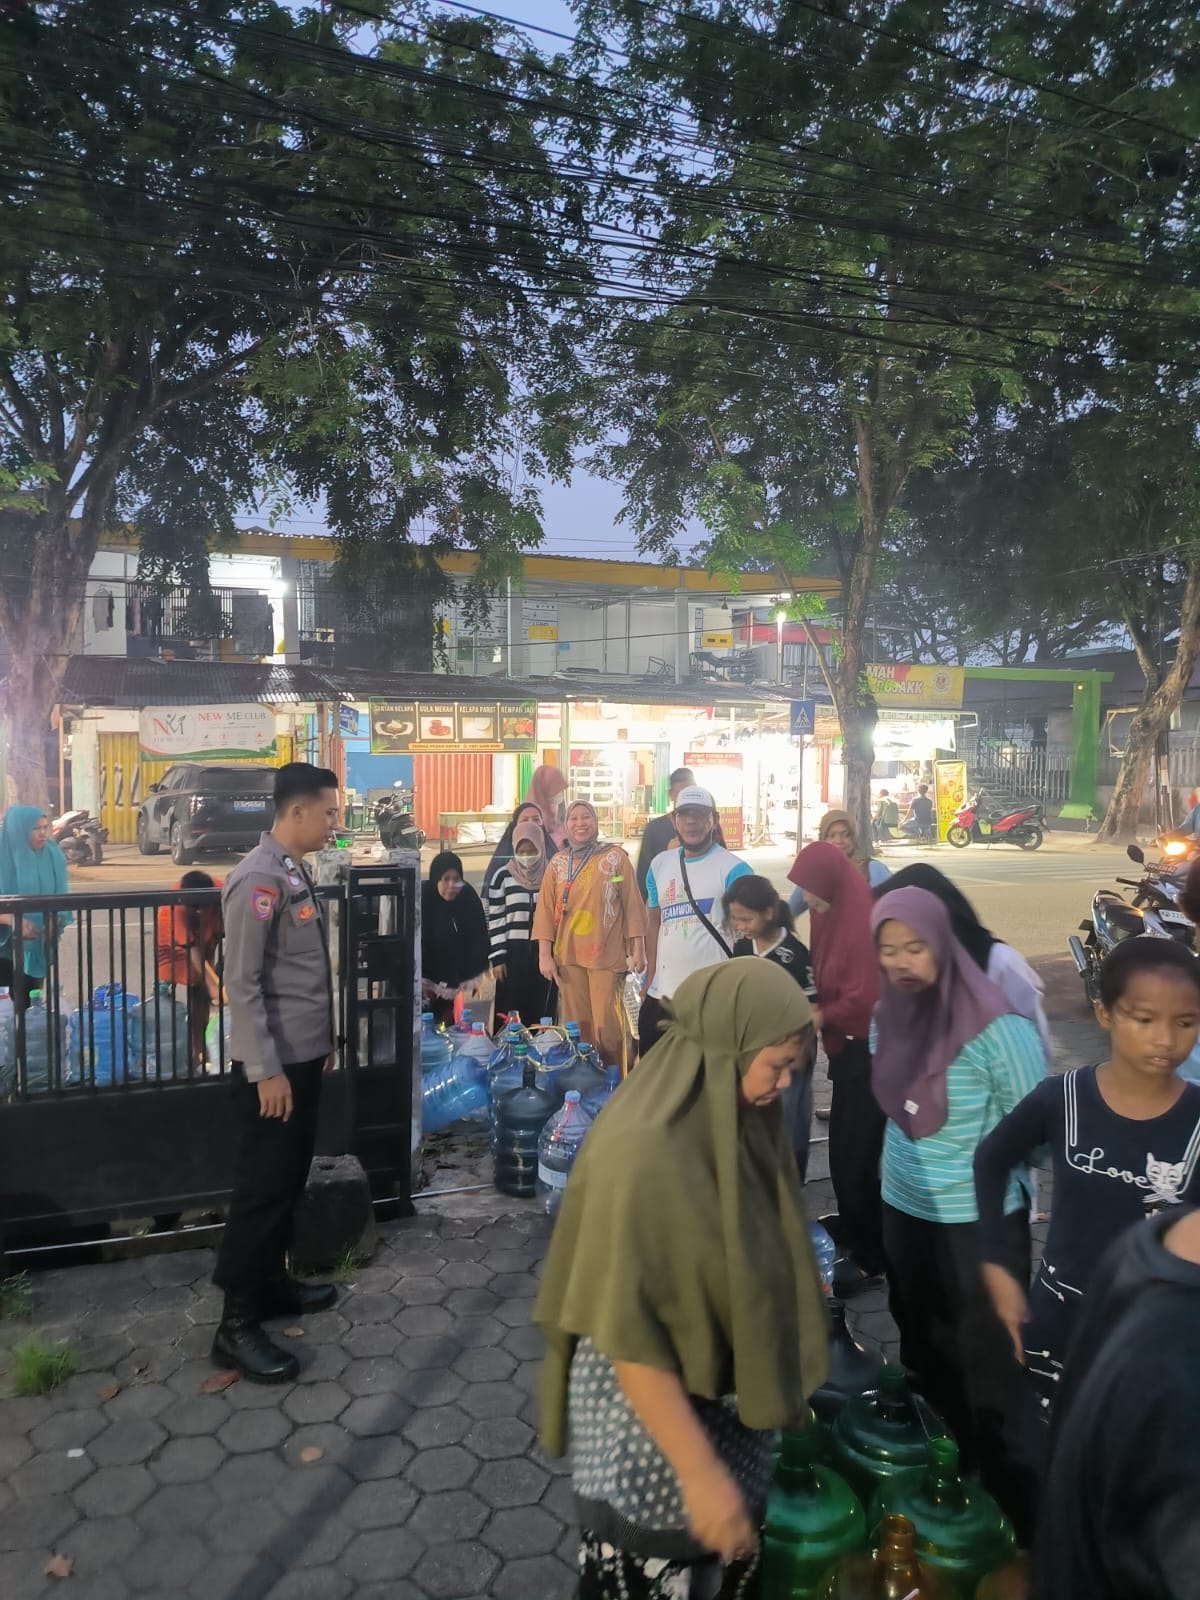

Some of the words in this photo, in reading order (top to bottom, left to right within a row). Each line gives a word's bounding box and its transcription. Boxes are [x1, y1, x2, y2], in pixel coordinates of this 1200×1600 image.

[198, 712, 223, 721] NEW
[226, 711, 242, 720] ME
[662, 902, 698, 919] TEAMWOR
